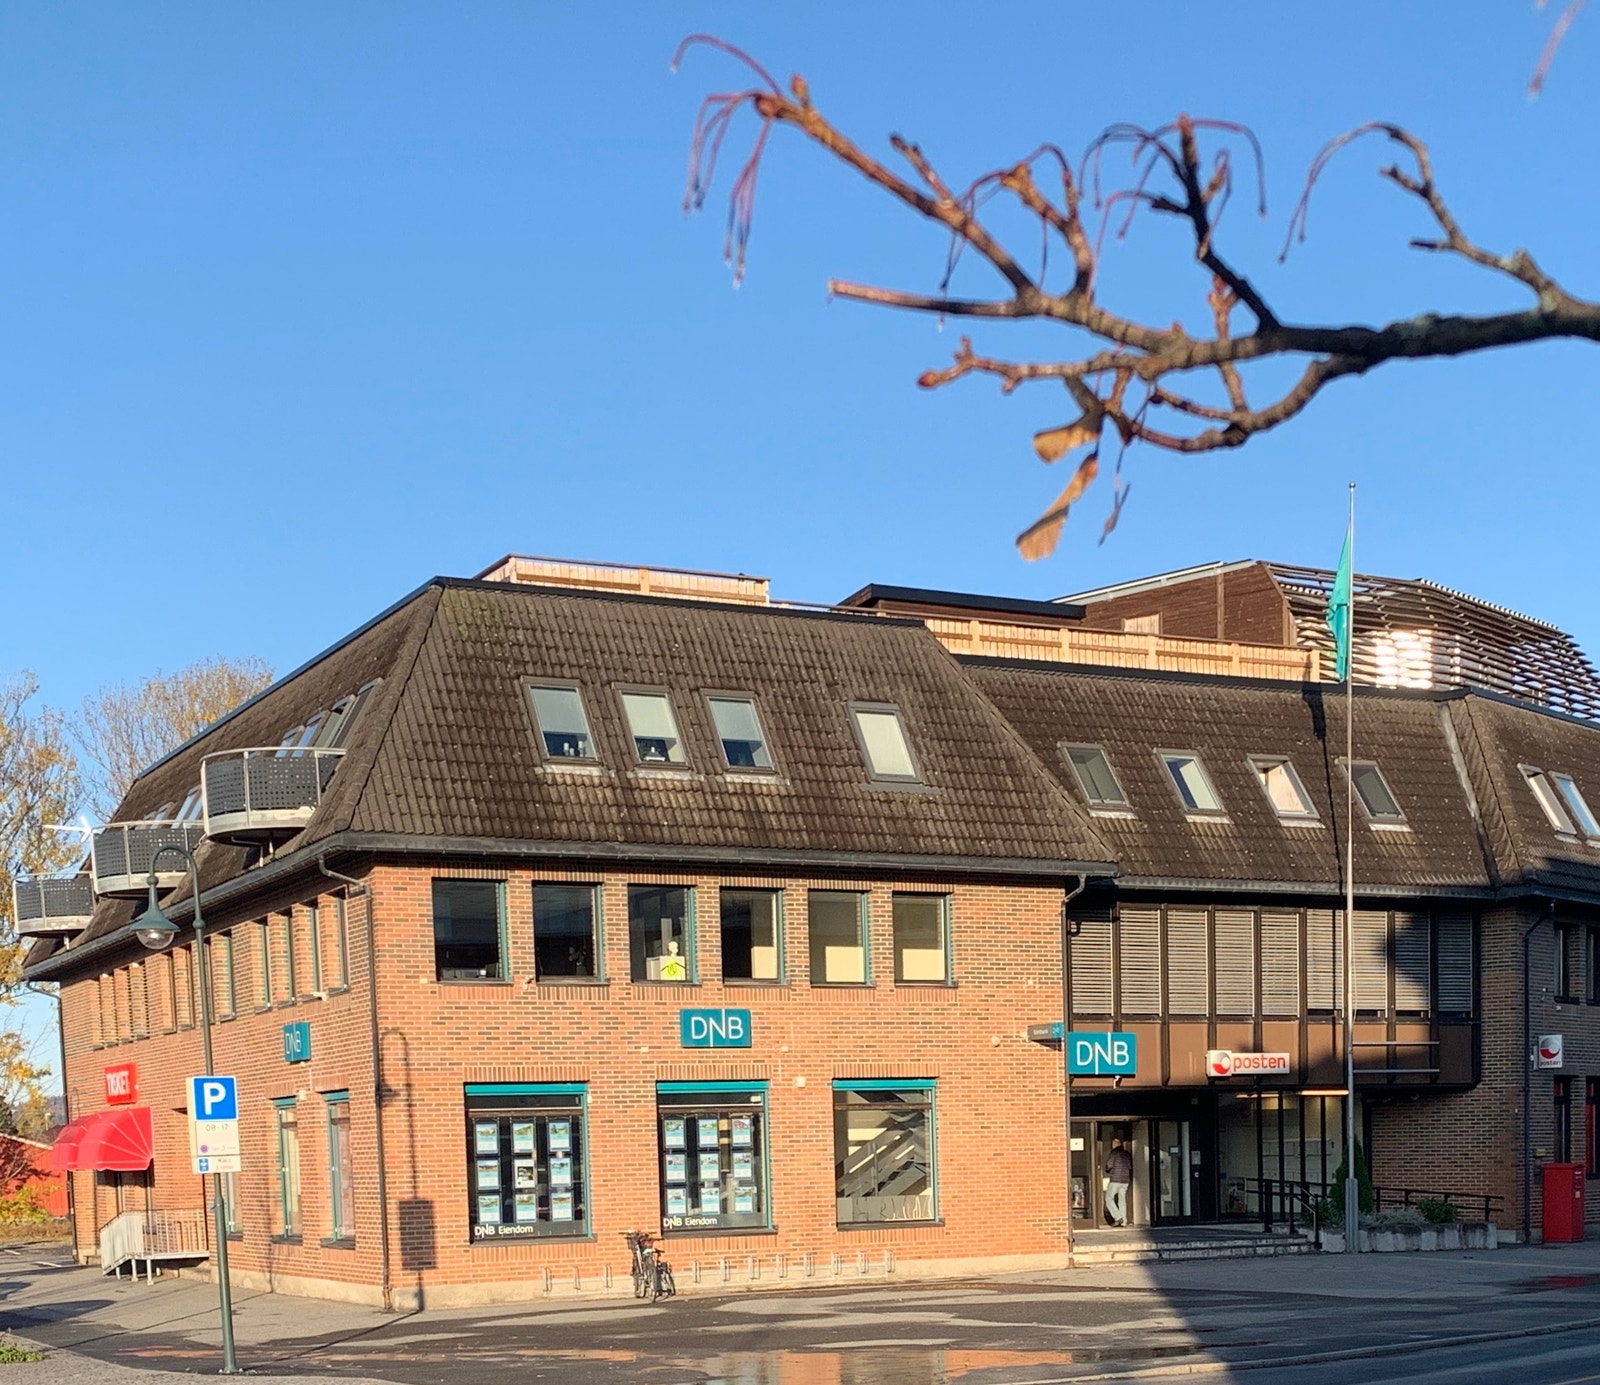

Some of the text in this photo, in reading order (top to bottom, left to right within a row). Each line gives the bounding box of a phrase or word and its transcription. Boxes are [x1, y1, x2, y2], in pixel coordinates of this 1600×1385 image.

[285, 1023, 302, 1061] DNB
[691, 1008, 744, 1047] DNB
[1076, 1032, 1130, 1075] DNB
[1233, 1054, 1286, 1072] posten
[203, 1082, 226, 1115] P
[474, 1223, 534, 1238] DNB Eiendom
[663, 1215, 718, 1229] DNB Eiendom
